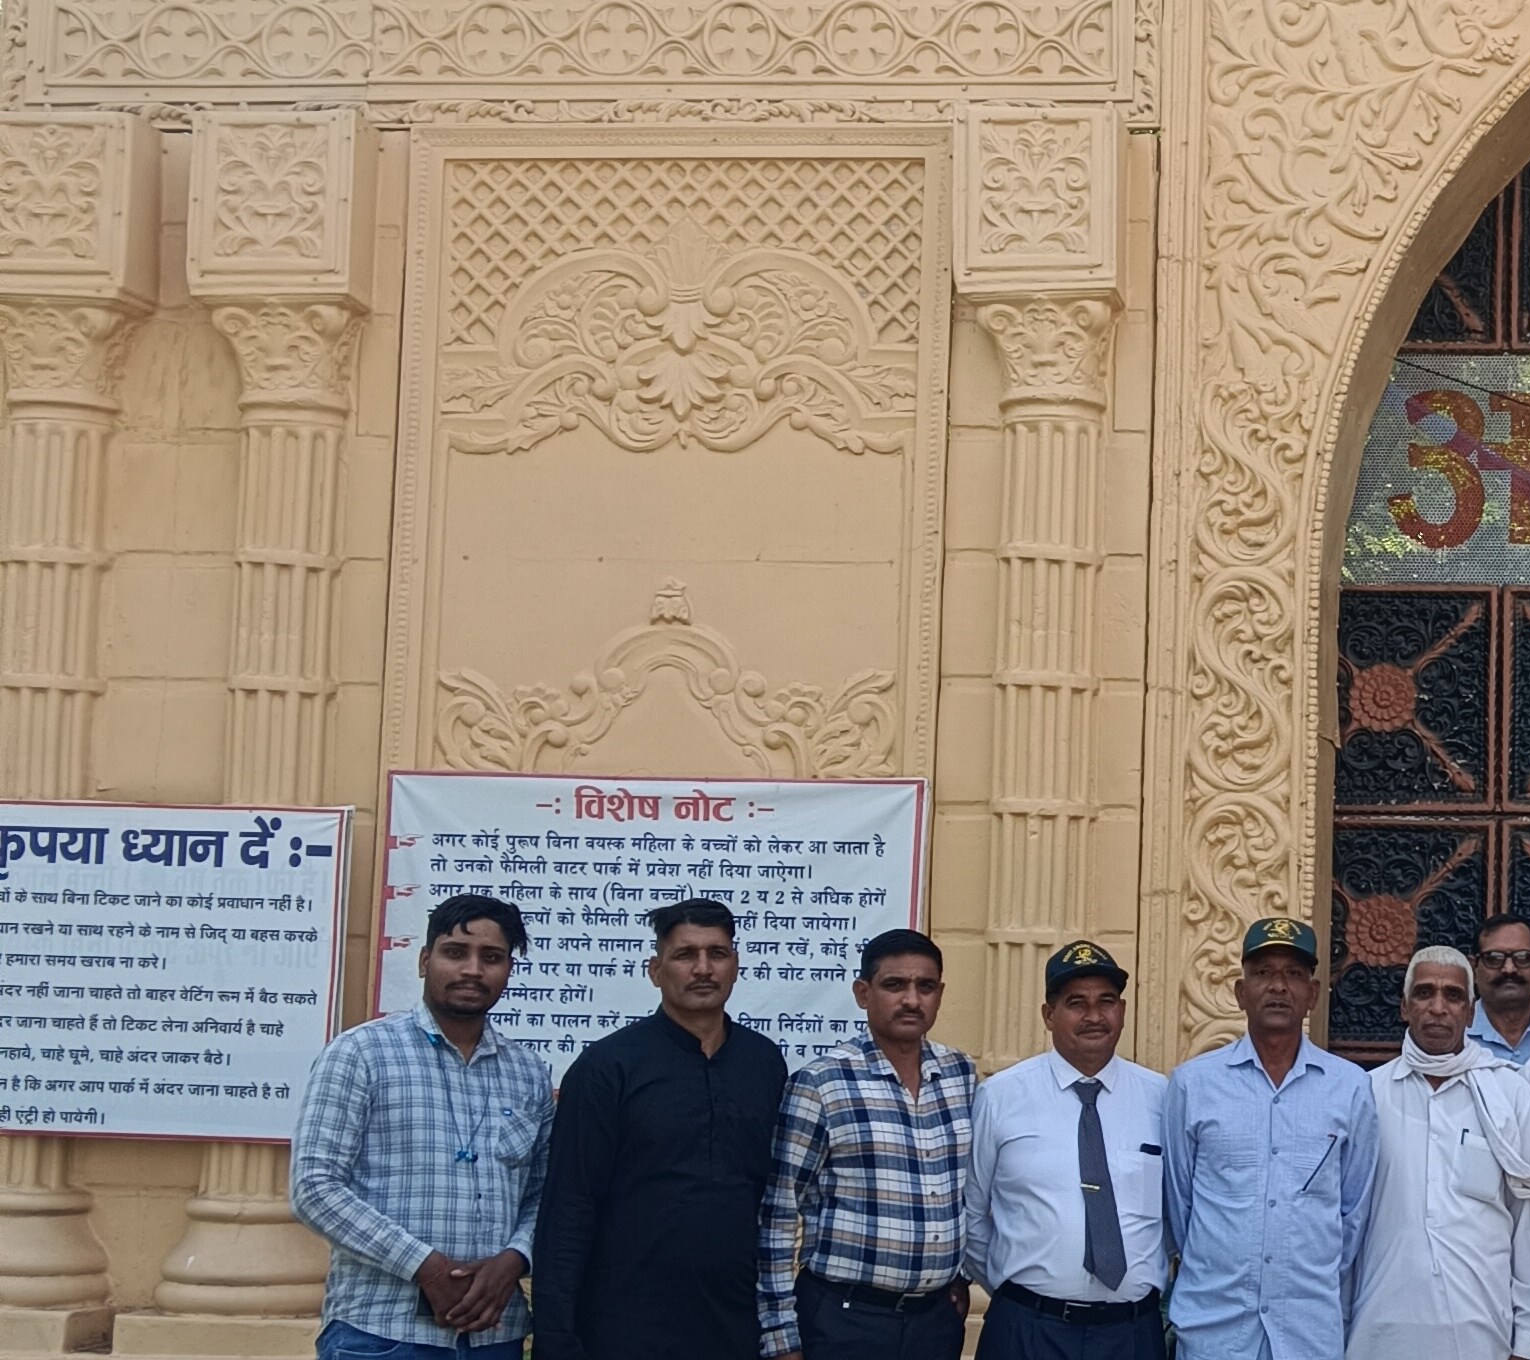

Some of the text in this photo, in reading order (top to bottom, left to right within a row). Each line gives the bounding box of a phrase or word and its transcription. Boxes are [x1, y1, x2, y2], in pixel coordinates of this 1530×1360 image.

[575, 785, 736, 822] विशेष नोट
[121, 828, 228, 867] ध्यान
[240, 816, 281, 868] दें
[432, 829, 885, 857] अगर कोई बिना वयस्क महिला के बच्चों को लेकर आ जाता है
[430, 852, 751, 879] तो उनको फैमिली वाटर पार्क में प्रवेश नहीं दिया
[15, 889, 27, 903] के
[63, 889, 89, 905] बिना
[94, 890, 130, 906] टिकट
[134, 891, 161, 907] जाने
[165, 896, 182, 908] का
[187, 893, 214, 910] कोई
[269, 894, 291, 911] नहीं
[549, 882, 562, 899] के
[741, 891, 750, 903] 2
[775, 891, 784, 904] 2
[791, 887, 803, 904] से
[810, 886, 853, 906] अधिक
[557, 907, 575, 925] को
[581, 904, 628, 926] फैमिली
[763, 911, 796, 930] दिया
[23, 920, 53, 934] रखने
[107, 921, 134, 938] रहने
[155, 926, 179, 938] नाम
[183, 923, 195, 938] से
[232, 929, 246, 940] या
[284, 927, 317, 942] करके
[557, 933, 592, 951] अपने
[598, 938, 643, 951] सामान
[746, 942, 780, 955] ध्यान
[820, 937, 848, 959] कोई
[5, 953, 76, 966] हमारा समय
[539, 962, 560, 976] पर
[566, 964, 581, 976] या
[588, 958, 616, 977] पार्क
[623, 960, 636, 977] में
[753, 962, 771, 980] की
[777, 963, 805, 980] चोट
[810, 964, 846, 981] लगने
[25, 981, 317, 1005] नहीं जाना चाहते तो सकते
[16, 1017, 46, 1028] जाना
[52, 1014, 85, 1030] चाहते
[102, 1014, 117, 1030] तो
[121, 1015, 157, 1031] टिकट
[161, 1016, 188, 1032] लेना
[259, 1019, 284, 1037] चाहे
[527, 1013, 545, 1027] का
[551, 1015, 592, 1028] पालन
[597, 1011, 620, 1028] करें
[778, 1012, 824, 1033] निर्देशों
[829, 1020, 848, 1033] का
[40, 1044, 65, 1061] चाहे
[99, 1046, 123, 1063] चाहे
[161, 1052, 199, 1064] जाकर
[557, 1034, 575, 1053] की
[24, 1075, 41, 1090] कि
[45, 1080, 75, 1091] अगर
[78, 1081, 104, 1092] आप
[109, 1078, 135, 1093] पार्क
[188, 1084, 219, 1096] जाना
[223, 1081, 257, 1098] चाहते
[275, 1083, 290, 1098] तो
